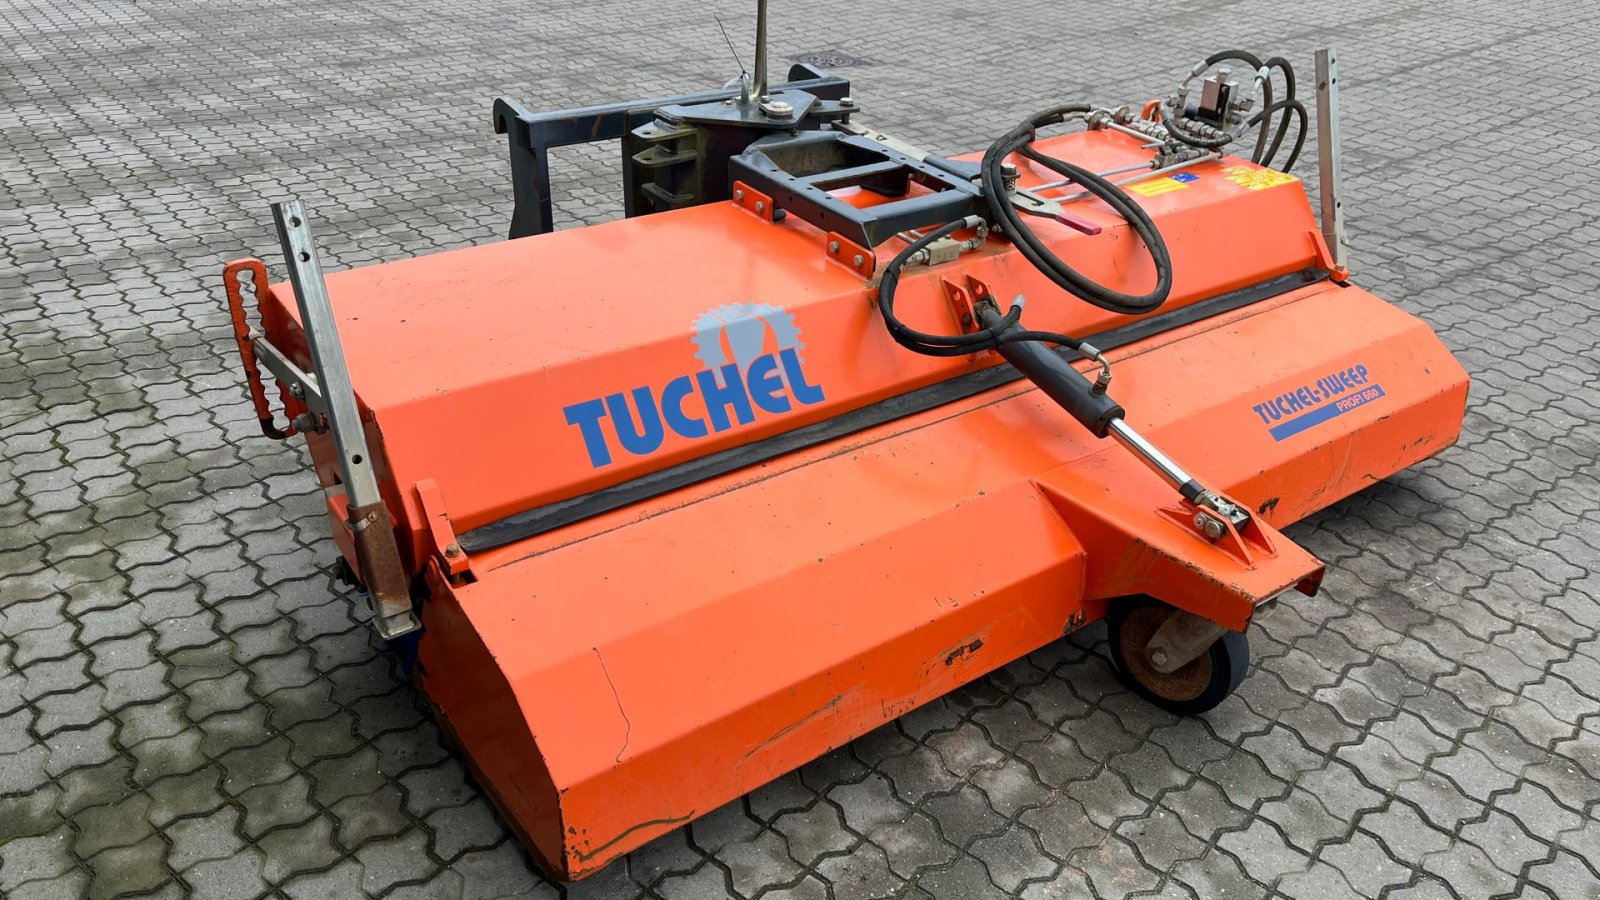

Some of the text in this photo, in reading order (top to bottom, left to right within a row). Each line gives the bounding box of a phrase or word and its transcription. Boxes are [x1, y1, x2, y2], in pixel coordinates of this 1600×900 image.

[563, 347, 825, 468] TUCHEL
[1253, 364, 1368, 424] TUCHEL-SWEEP
[1336, 394, 1364, 412] PROFI
